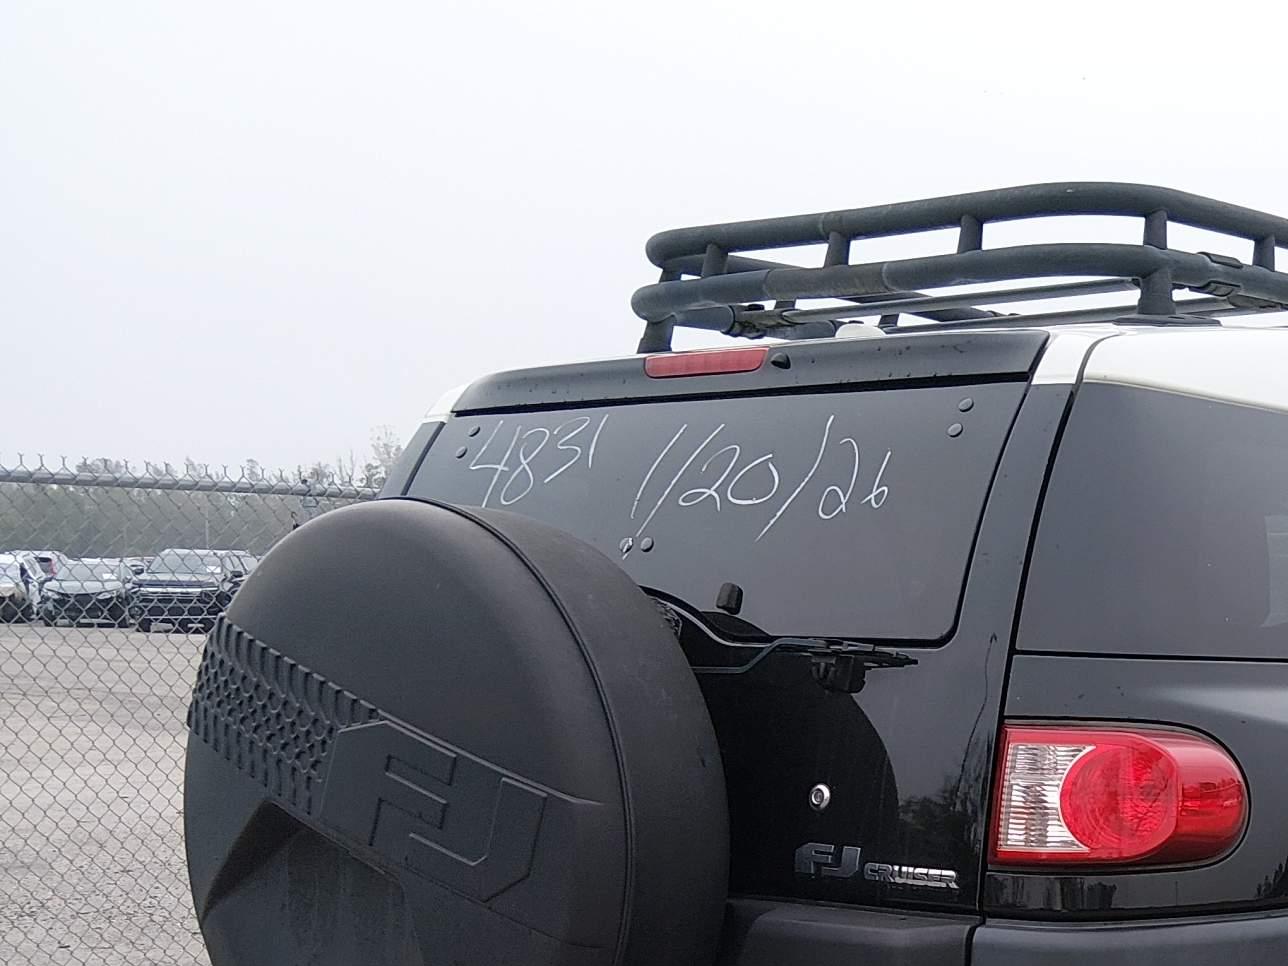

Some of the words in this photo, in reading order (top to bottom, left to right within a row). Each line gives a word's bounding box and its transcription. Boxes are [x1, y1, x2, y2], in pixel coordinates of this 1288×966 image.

[468, 413, 608, 509] 4831
[622, 414, 892, 557] 1/20/26
[321, 720, 548, 904] FJ
[794, 841, 861, 879] FJ
[862, 861, 960, 889] CRUISER
